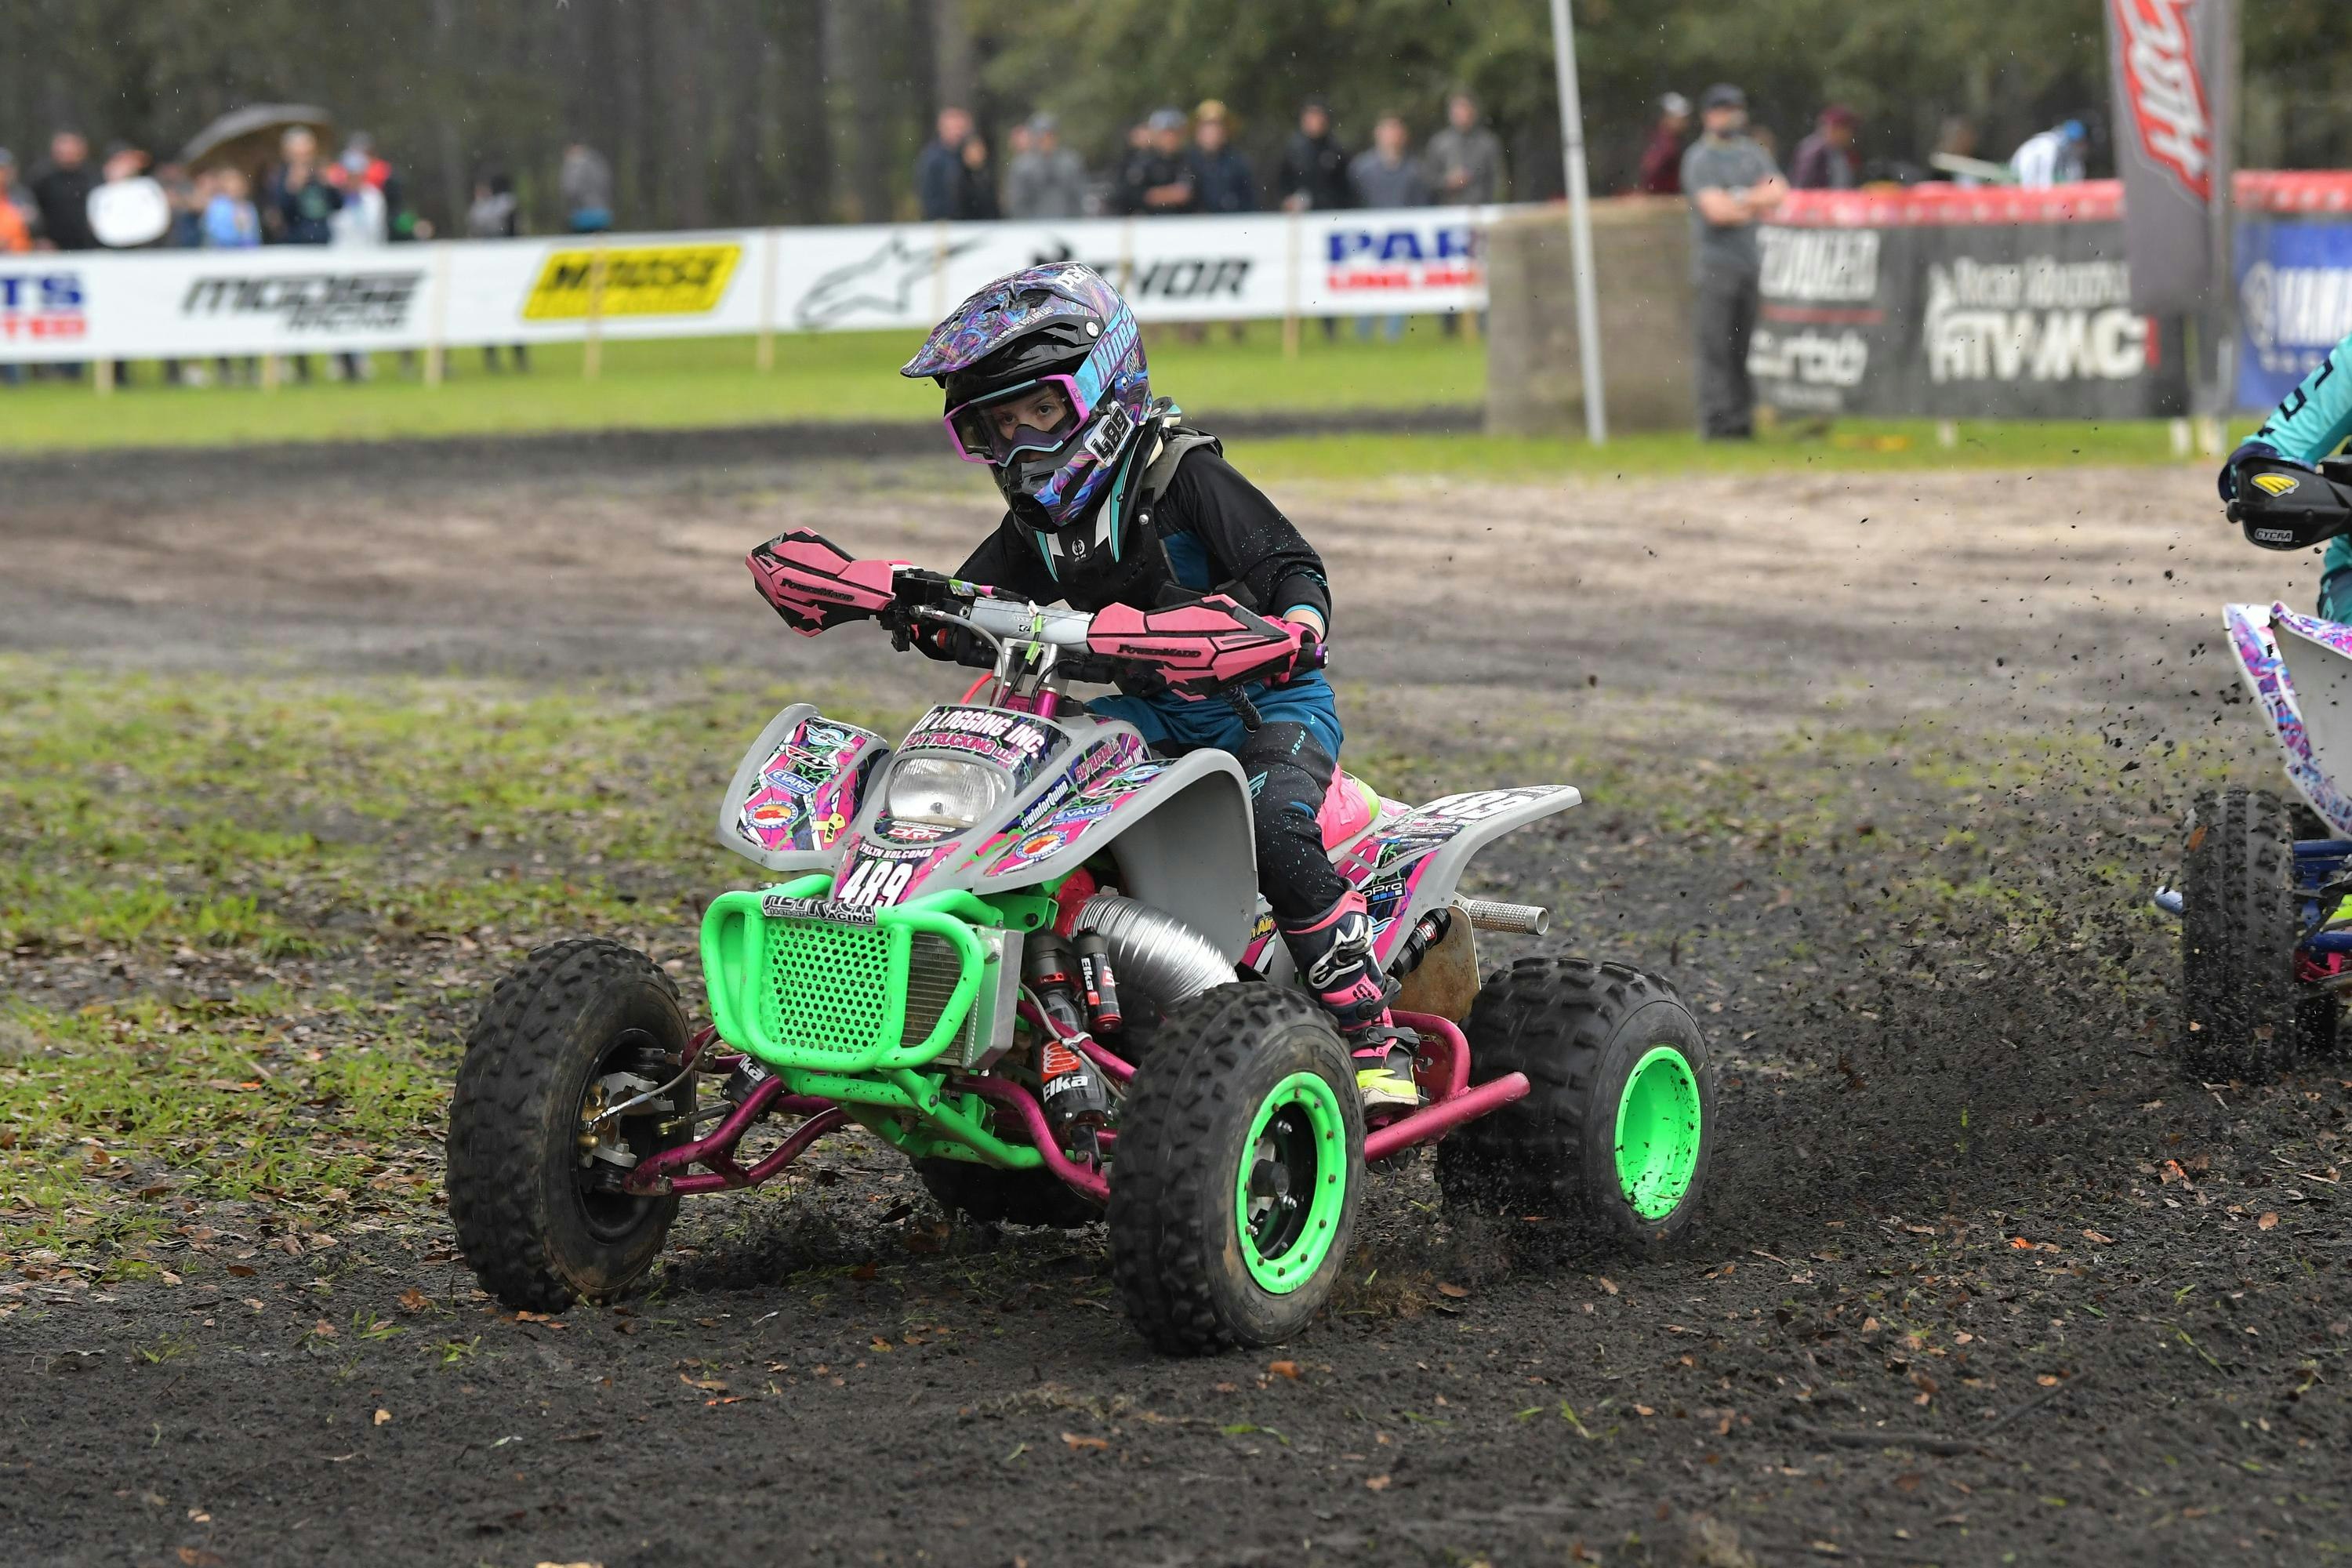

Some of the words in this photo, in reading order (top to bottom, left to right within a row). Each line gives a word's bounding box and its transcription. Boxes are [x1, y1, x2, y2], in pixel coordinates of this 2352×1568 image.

[928, 732, 996, 753] TRUCKING
[993, 746, 1016, 763] LLC
[931, 710, 1014, 737] LOGGING
[1004, 724, 1045, 759] INC.
[772, 771, 814, 793] EVANS
[1021, 781, 1069, 831] #winforQuinn
[837, 860, 913, 907] 489
[1363, 883, 1402, 898] oPro
[739, 1056, 766, 1082] ka
[1043, 1076, 1088, 1103] Elka
